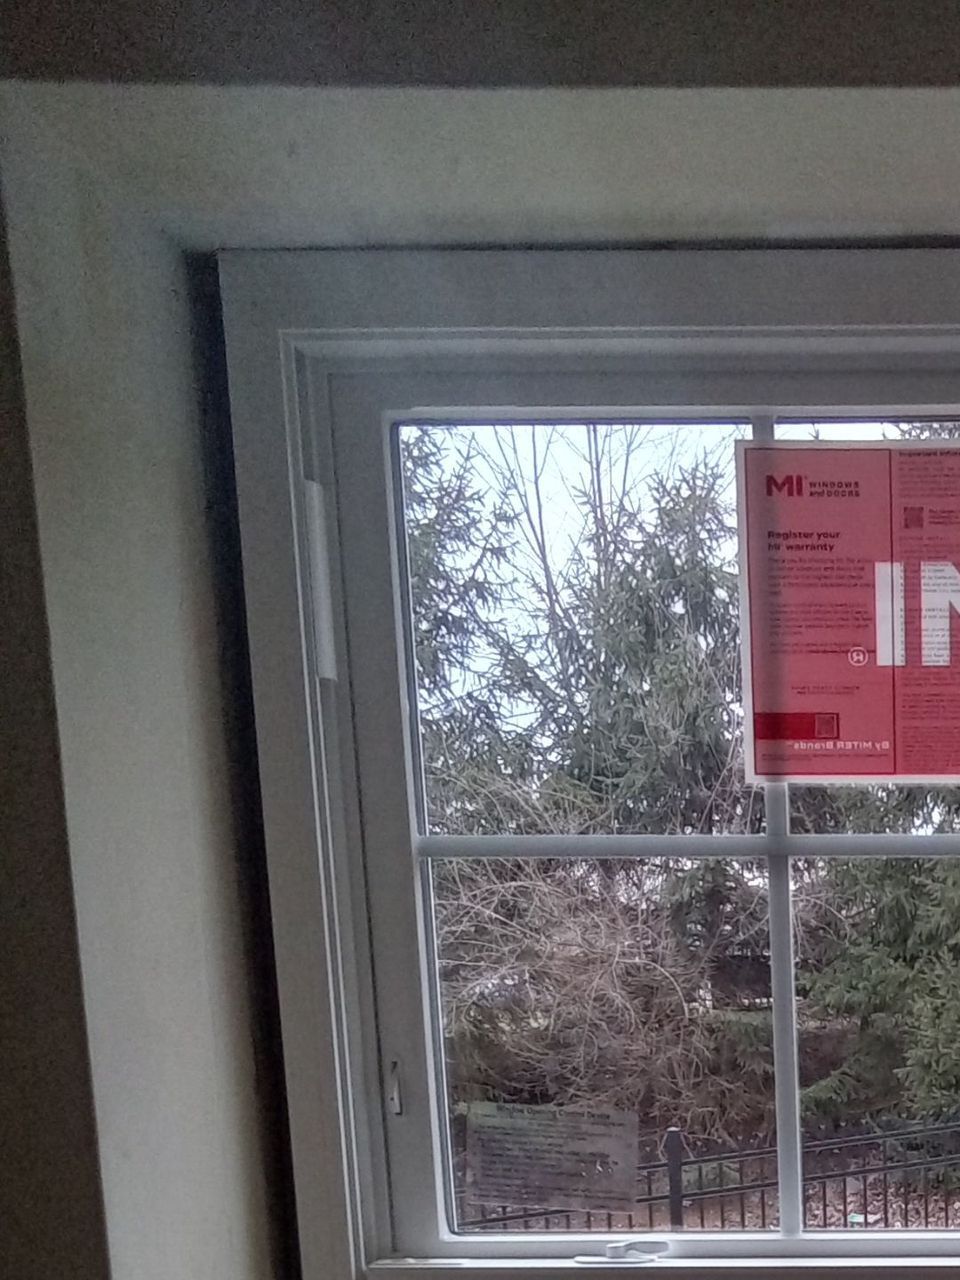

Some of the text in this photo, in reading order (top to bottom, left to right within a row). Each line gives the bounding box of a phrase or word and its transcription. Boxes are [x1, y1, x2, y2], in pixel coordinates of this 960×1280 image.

[766, 475, 804, 497] MI
[809, 481, 860, 489] WINDOWS
[767, 530, 841, 541] Register your
[785, 543, 835, 552] warranty
